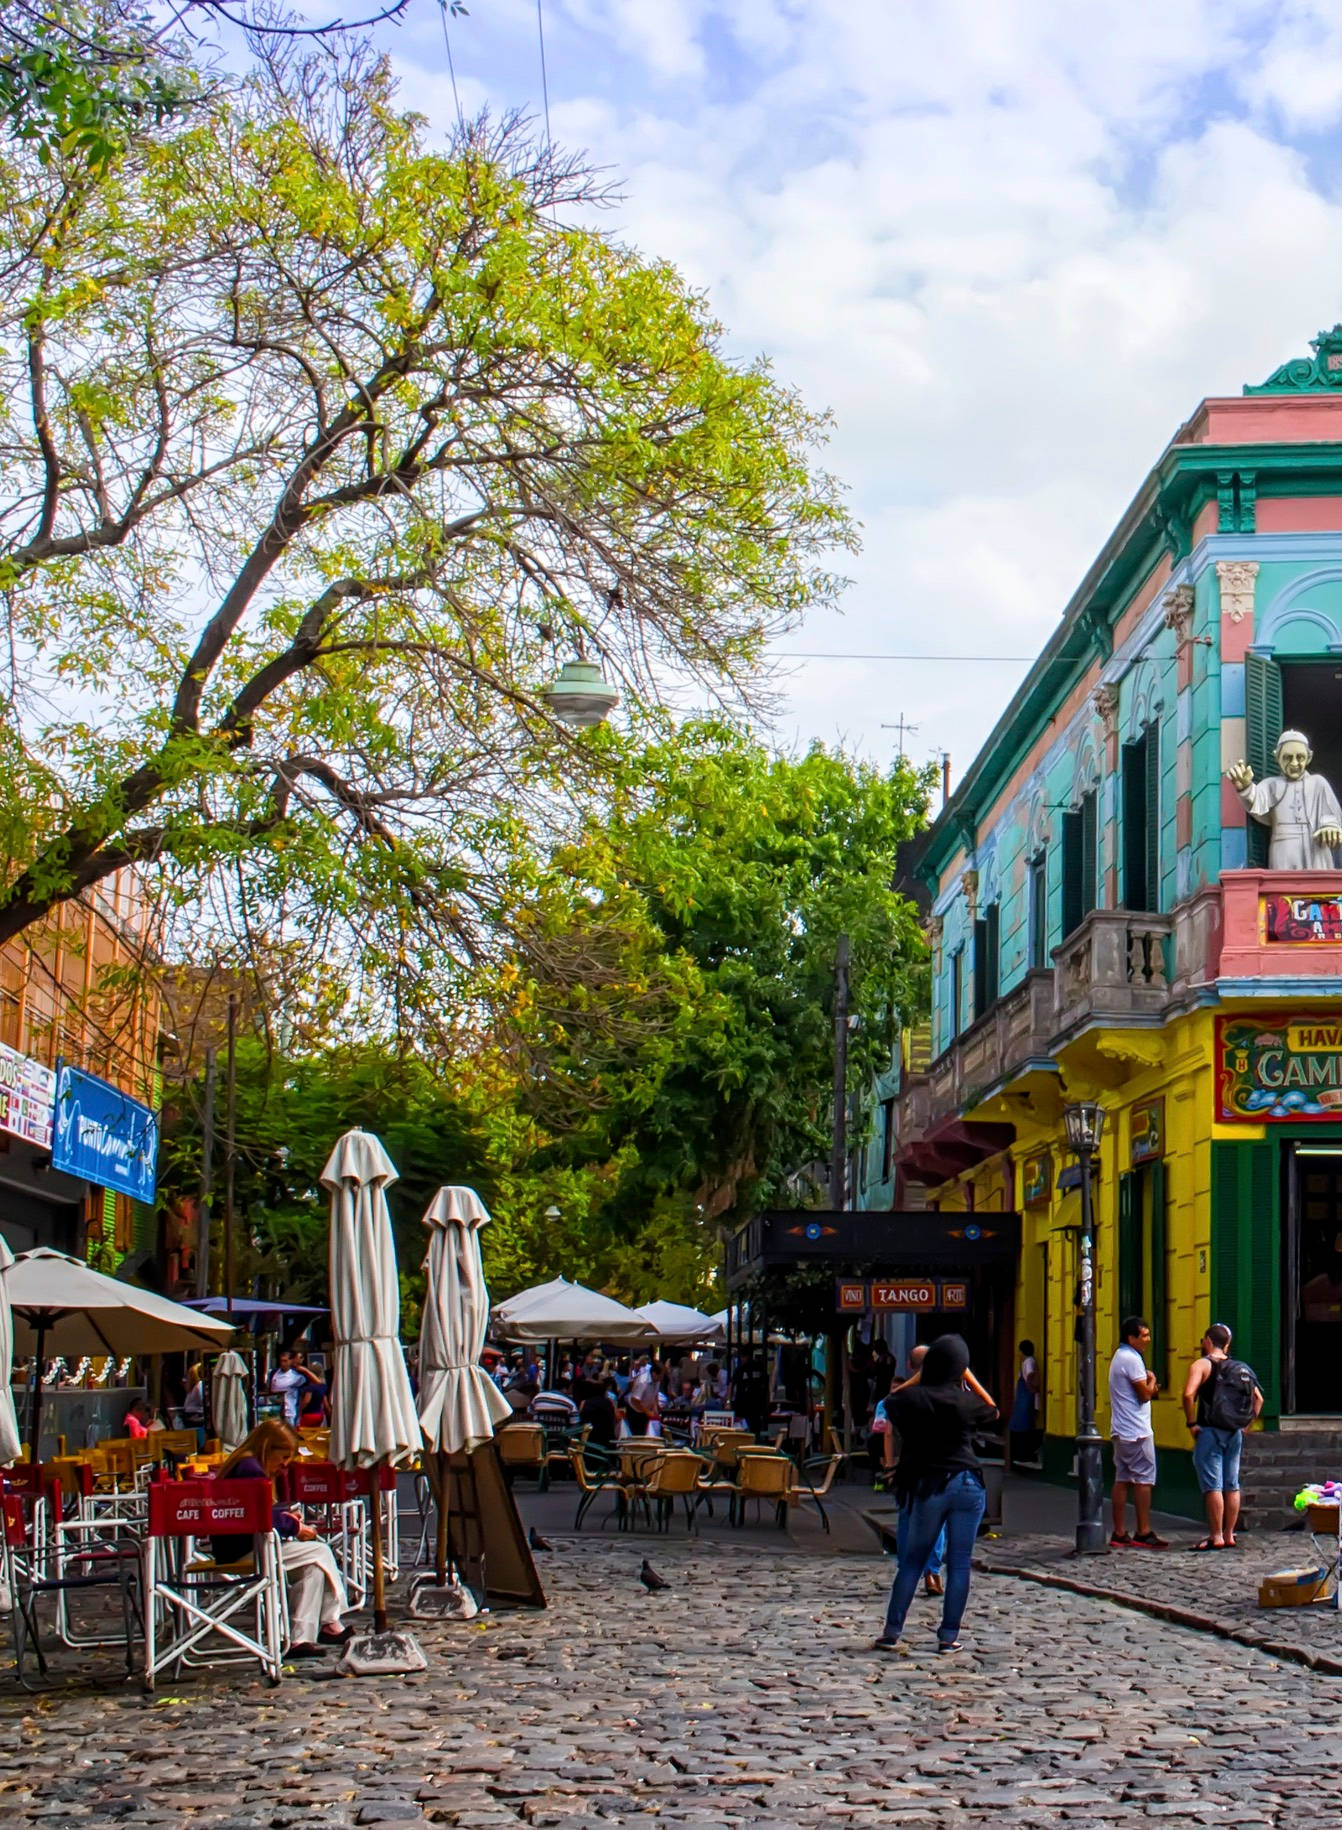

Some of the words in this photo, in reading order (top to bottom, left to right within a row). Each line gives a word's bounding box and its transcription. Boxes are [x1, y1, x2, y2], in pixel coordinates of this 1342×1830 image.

[878, 1289, 929, 1304] TANGO
[176, 1509, 200, 1520] CAFE
[211, 1507, 245, 1519] COFFEE
